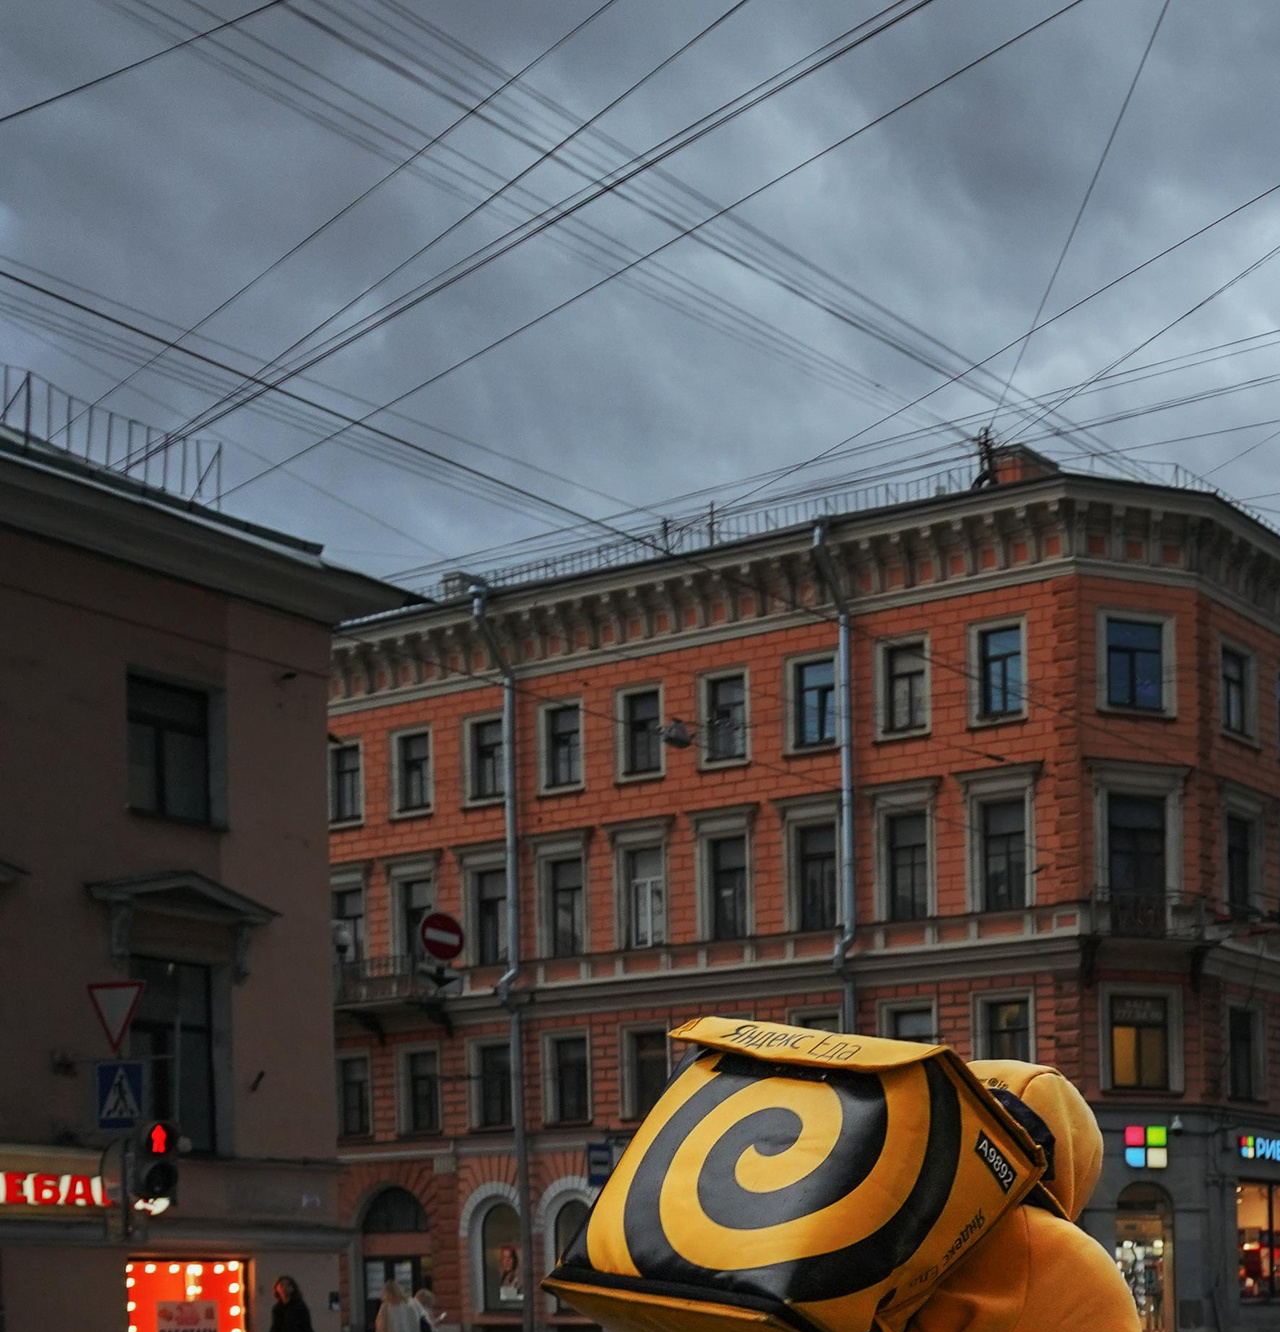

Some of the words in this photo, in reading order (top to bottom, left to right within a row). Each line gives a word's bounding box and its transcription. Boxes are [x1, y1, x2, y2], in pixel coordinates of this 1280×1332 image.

[720, 1024, 814, 1050] Яндекс
[807, 1034, 862, 1062] Еда
[978, 1139, 1014, 1189] A9892
[3, 1171, 116, 1207] ЕБА
[942, 1208, 987, 1268] Яндекс
